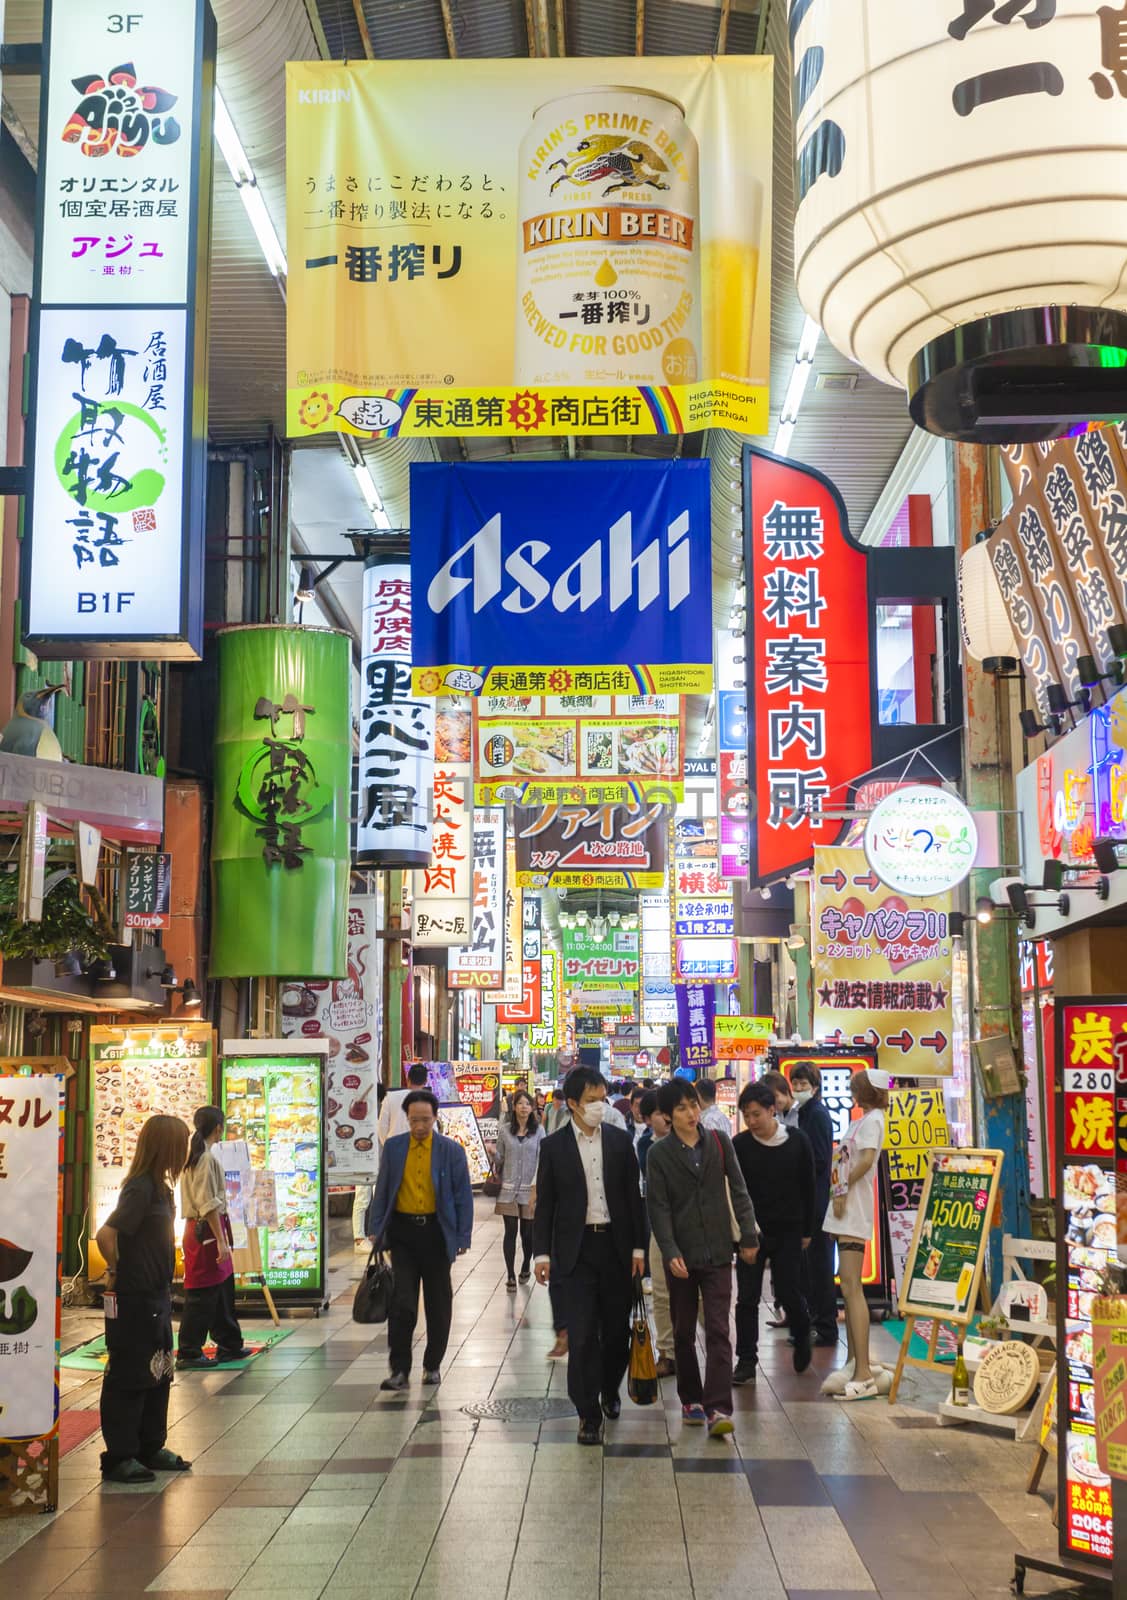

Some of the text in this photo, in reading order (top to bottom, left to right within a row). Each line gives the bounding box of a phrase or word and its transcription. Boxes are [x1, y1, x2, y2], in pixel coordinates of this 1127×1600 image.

[107, 14, 143, 33] 3F
[299, 89, 350, 104] KIRIN
[528, 112, 689, 182] KIRIN'S PRIME BREW
[59, 177, 179, 193] オリエンタル
[306, 174, 506, 194] うまさにこだわると、
[622, 192, 652, 201] PRESS
[59, 200, 179, 218] 個室居酒屋
[304, 200, 506, 221] 一番搾り製法になる。
[529, 211, 686, 247] KIRIN BEER
[71, 234, 164, 258] アジュ
[306, 243, 462, 282] 一番搾り
[521, 290, 693, 357] BREWED FOR GOOD TIMES
[559, 301, 651, 325] 一番搾り
[143, 331, 168, 411] 居酒屋
[357, 400, 384, 413] よう
[689, 389, 757, 404] HIGASHIDORI
[689, 400, 729, 411] DAISAN
[352, 412, 390, 426] おこし
[689, 409, 748, 423] SHOTENGAI
[427, 510, 690, 614] Asahi
[77, 592, 135, 613] B1F
[764, 502, 828, 828] 無料案内所
[128, 854, 141, 910] イタリアン
[142, 855, 154, 913] ペンギンバー
[126, 914, 151, 928] 30m
[820, 909, 948, 940] キャバクラ!!
[566, 957, 639, 977] サイゼリヤ
[833, 981, 933, 1009] 激安情報満載
[1070, 1011, 1113, 1065] 炭
[1072, 1072, 1112, 1090] 280
[1070, 1096, 1114, 1150] 焼
